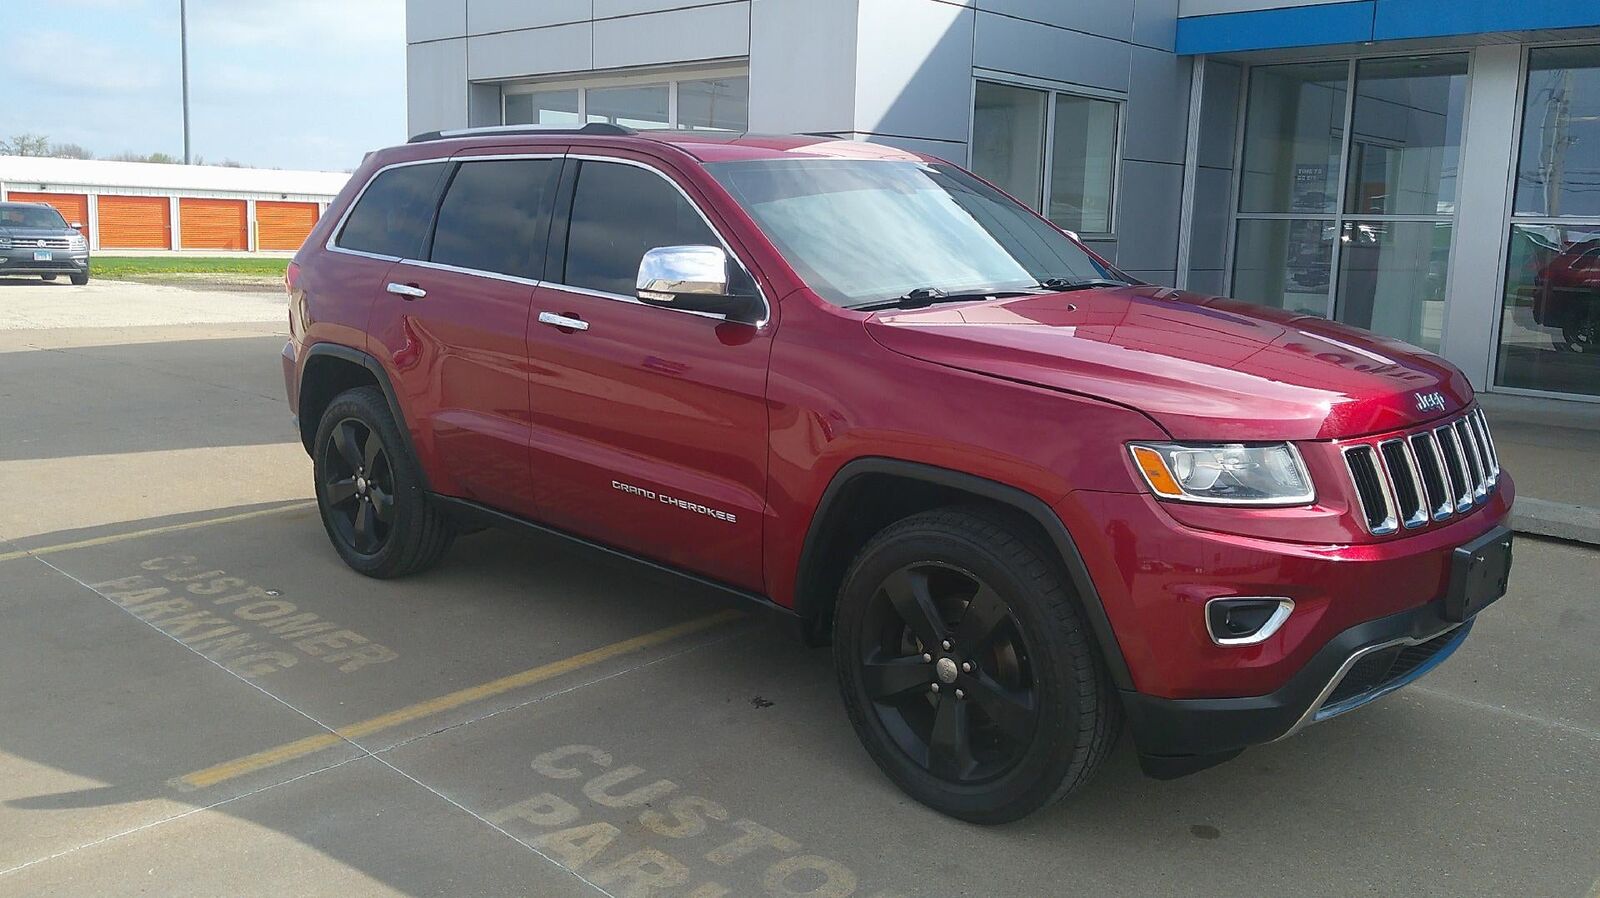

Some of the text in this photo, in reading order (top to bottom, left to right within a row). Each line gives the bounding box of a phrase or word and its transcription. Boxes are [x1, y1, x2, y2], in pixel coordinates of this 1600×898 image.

[1414, 392, 1445, 411] Jeep
[611, 480, 737, 523] GRAND CHEROKEE
[91, 575, 298, 678] PARKING
[140, 555, 399, 674] CUSTOMER
[487, 792, 731, 898] PAR
